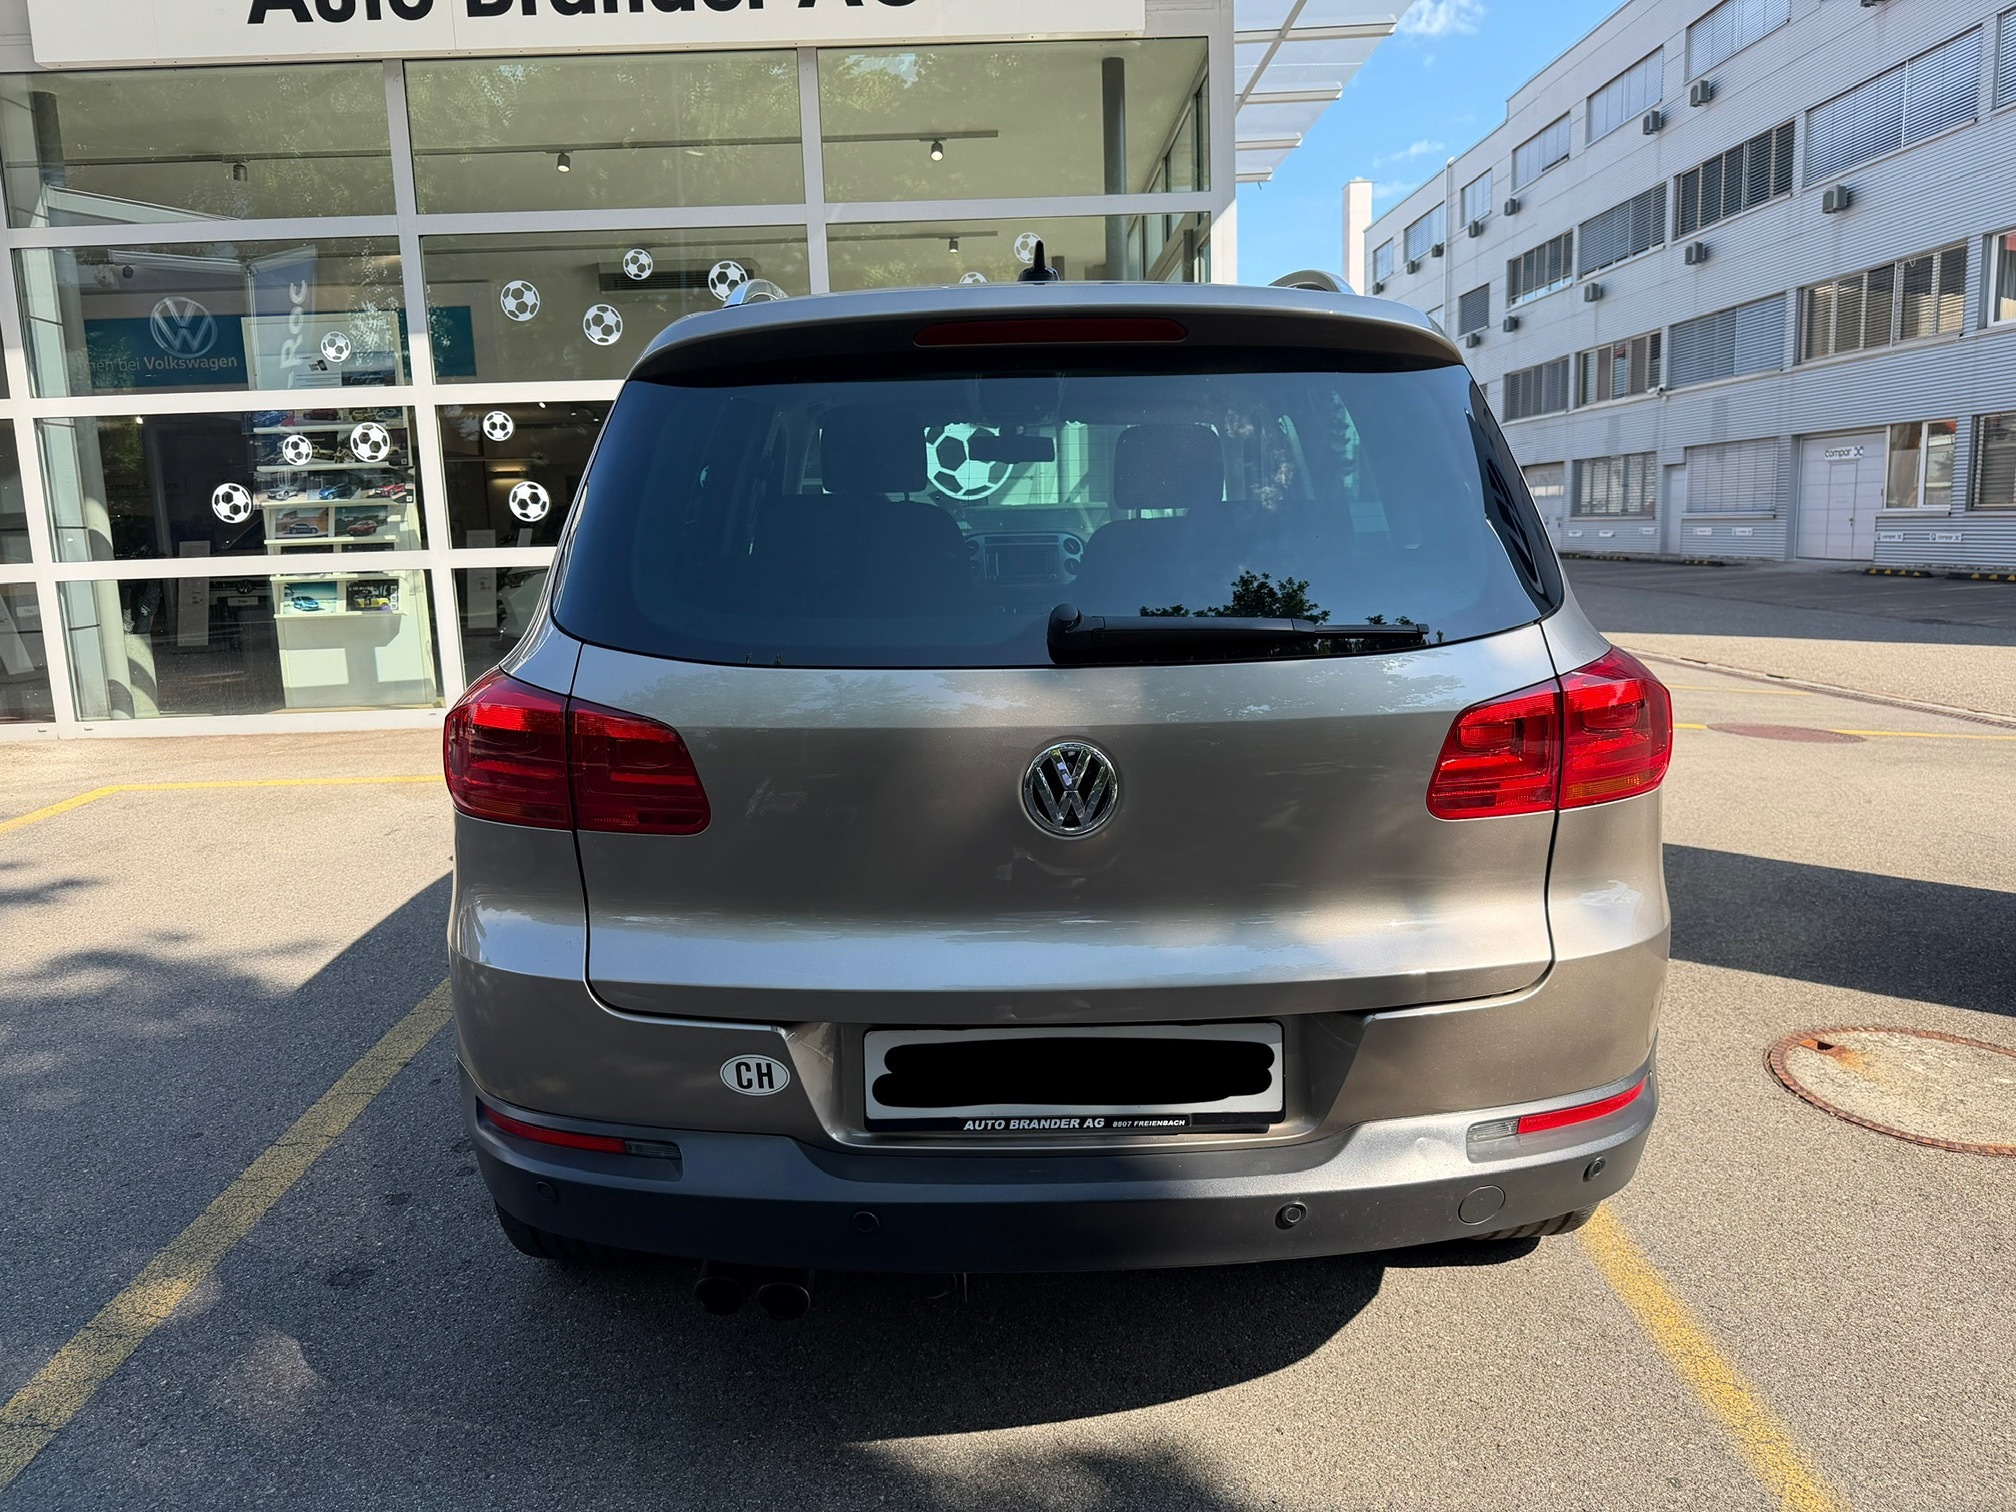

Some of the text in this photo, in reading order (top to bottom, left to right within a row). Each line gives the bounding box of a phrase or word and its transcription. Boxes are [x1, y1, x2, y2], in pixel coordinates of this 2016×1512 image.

[118, 357, 140, 371] bei
[144, 356, 238, 371] Volkswagen
[735, 1061, 775, 1089] CH
[963, 1119, 1006, 1131] AUTO
[1009, 1118, 1080, 1130] BRANDER
[1083, 1118, 1105, 1129] AG
[1133, 1119, 1186, 1127] FREIENBACH
